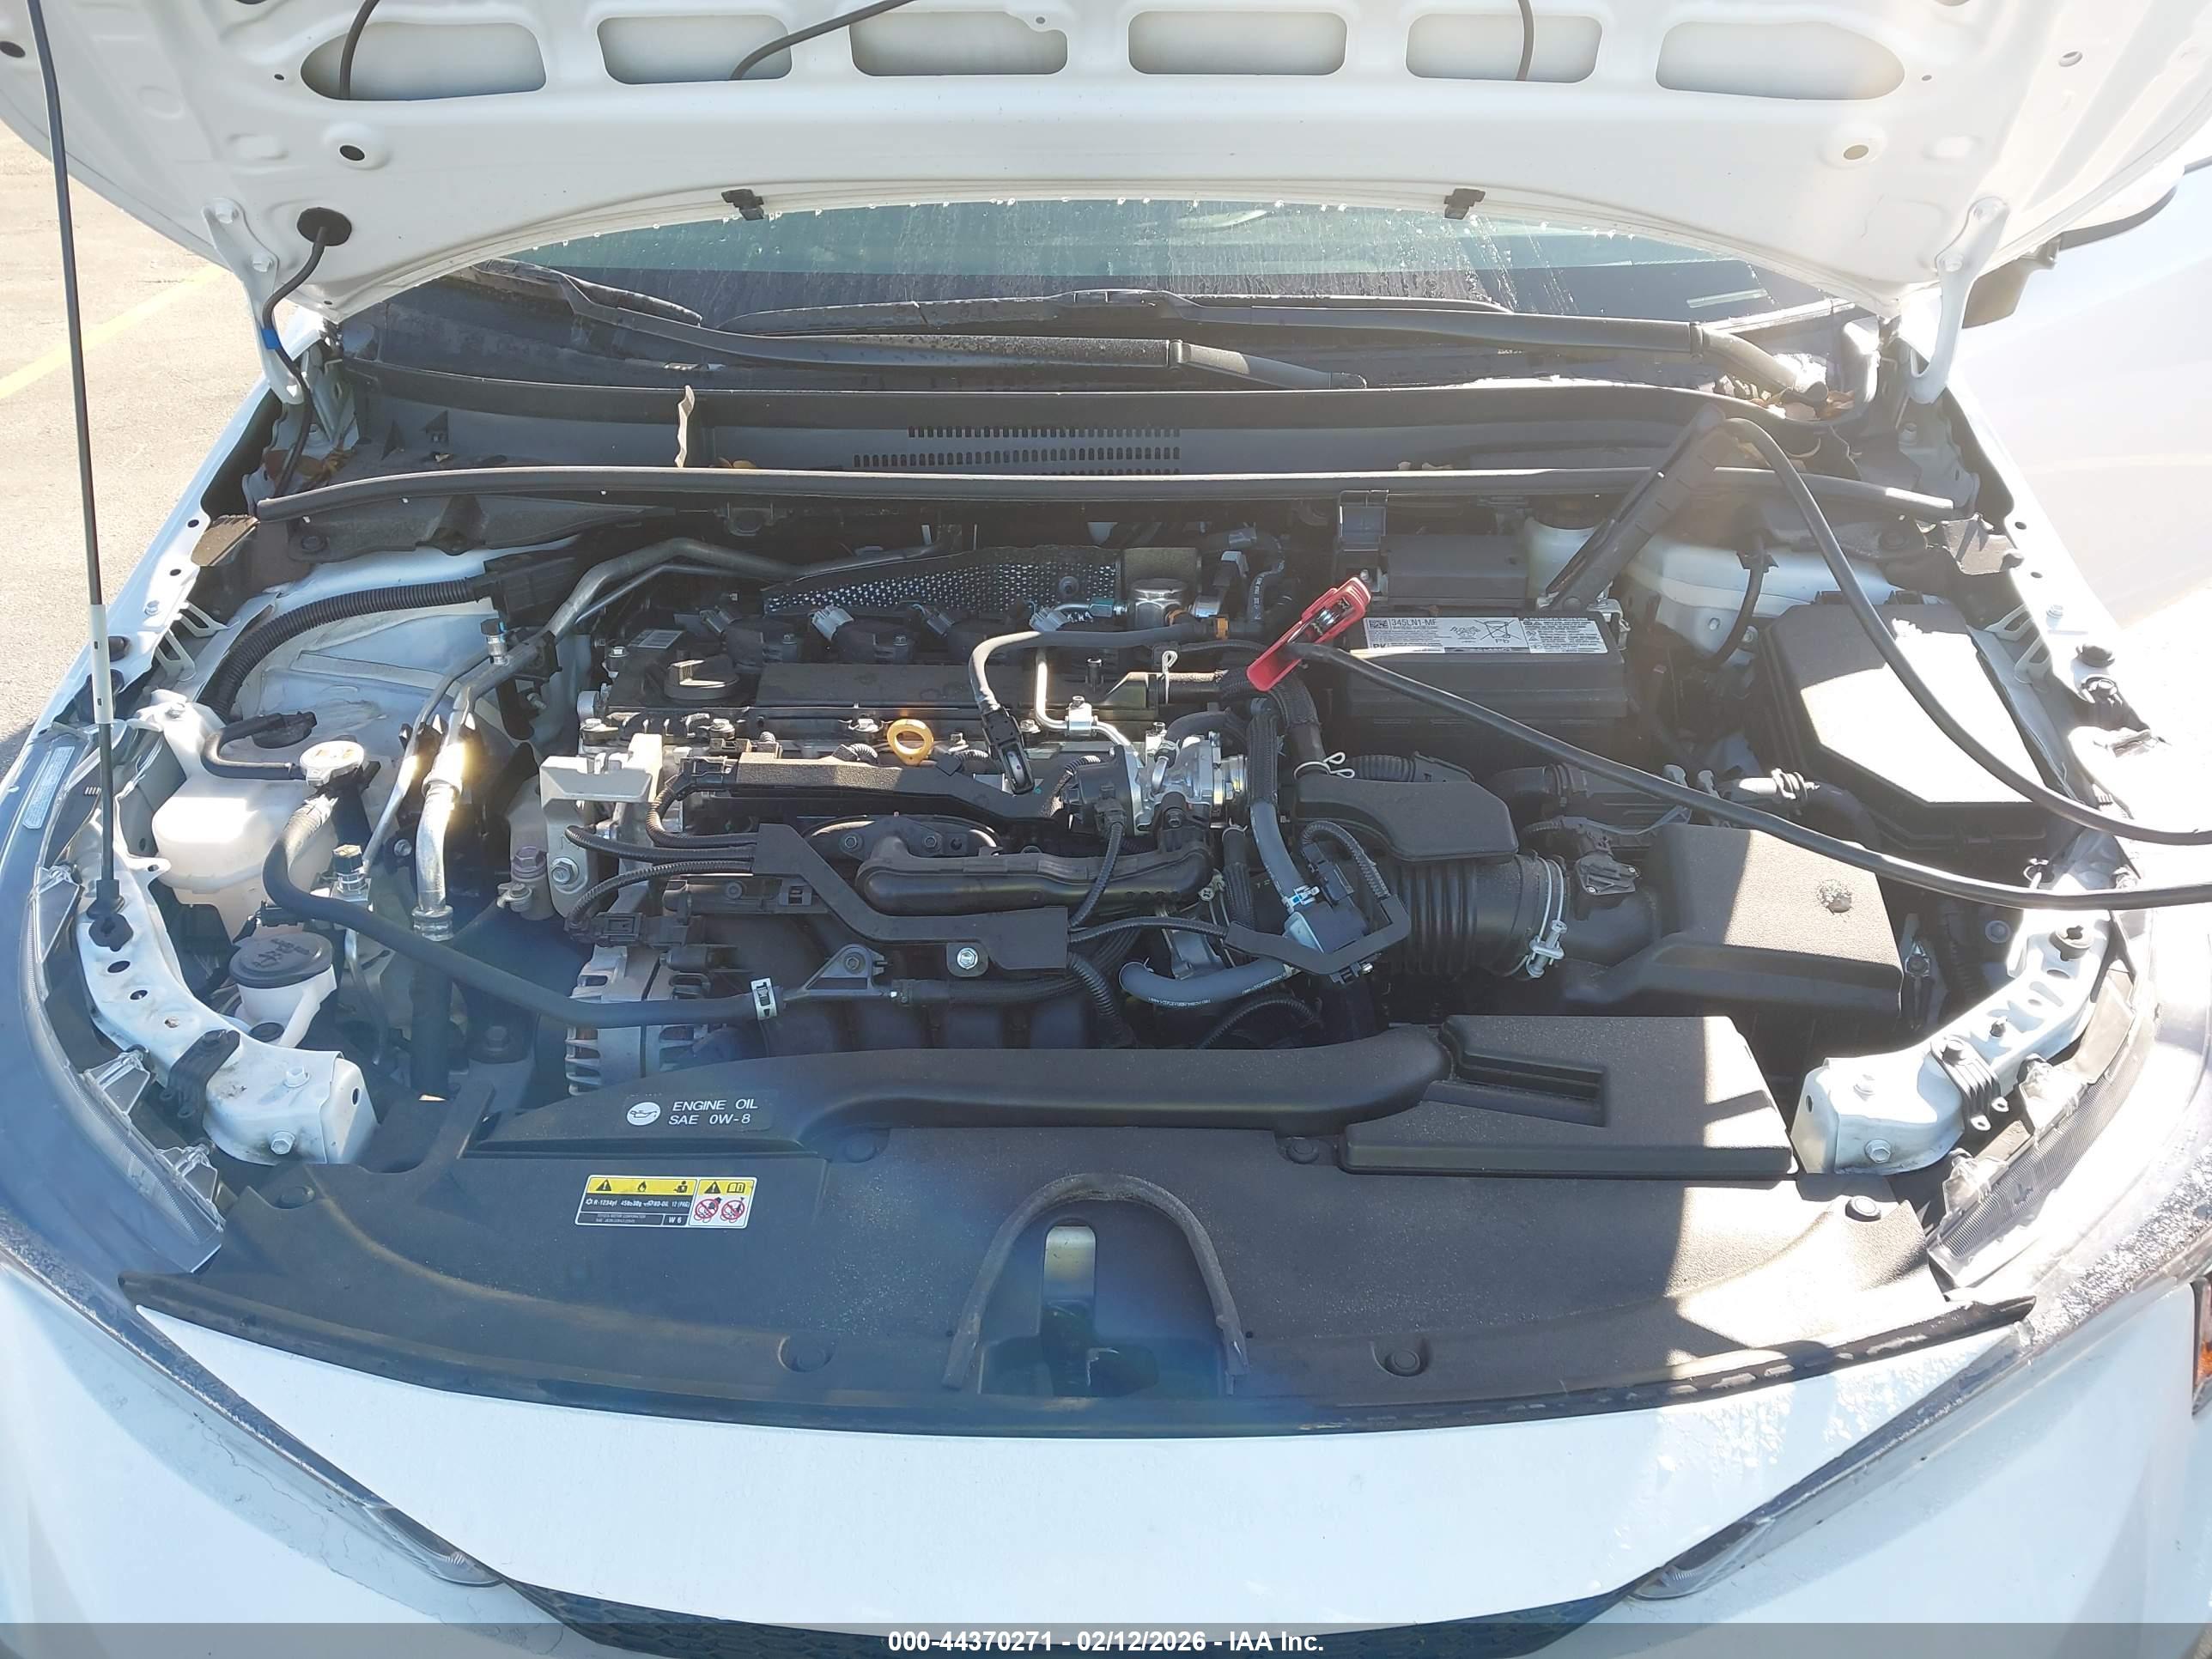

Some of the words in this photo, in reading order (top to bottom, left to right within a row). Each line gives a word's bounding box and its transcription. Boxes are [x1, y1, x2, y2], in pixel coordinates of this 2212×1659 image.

[672, 1099, 726, 1111] ENGINE
[735, 1098, 758, 1109] OIL
[668, 1115, 699, 1125] SAE
[708, 1114, 750, 1125] 0W-8
[593, 1199, 617, 1207] R-1234yf
